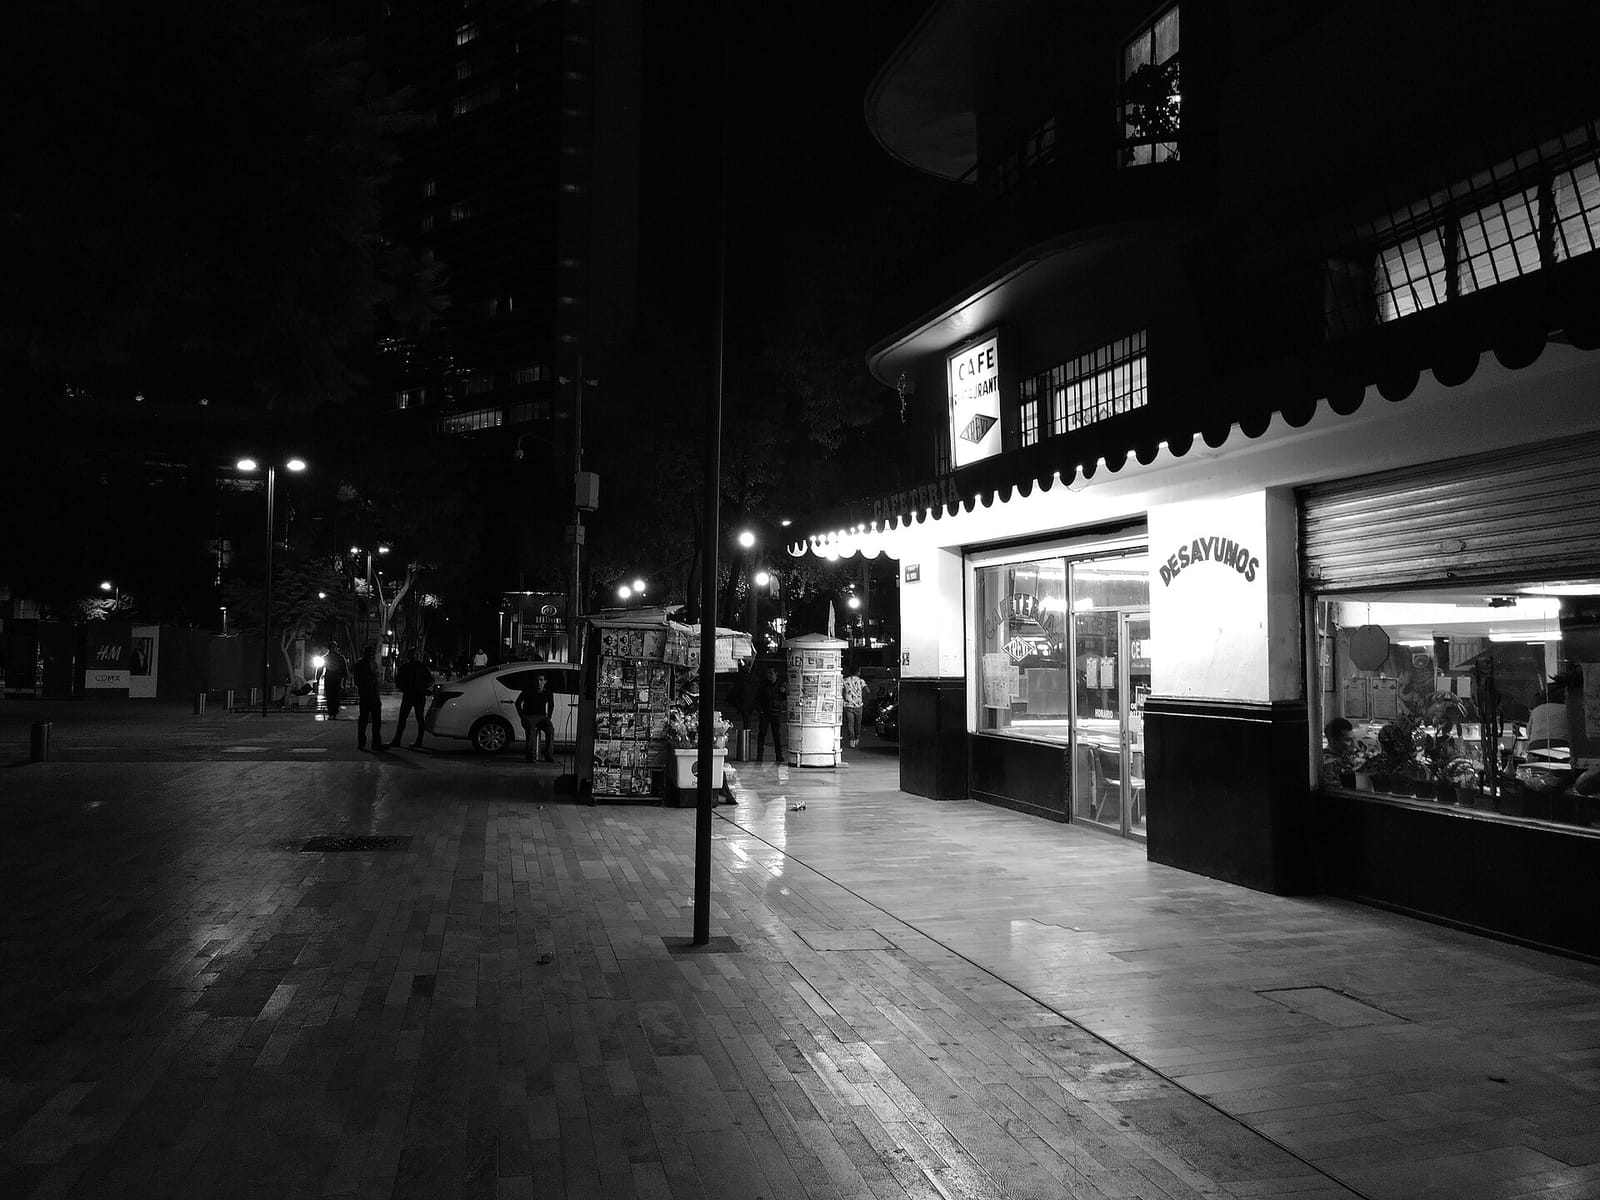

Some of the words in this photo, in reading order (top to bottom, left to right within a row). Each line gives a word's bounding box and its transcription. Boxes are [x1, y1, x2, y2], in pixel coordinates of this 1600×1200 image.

[958, 346, 995, 381] CAFE
[873, 476, 960, 519] CAFETERIA
[1159, 536, 1259, 587] DESAYUNOS
